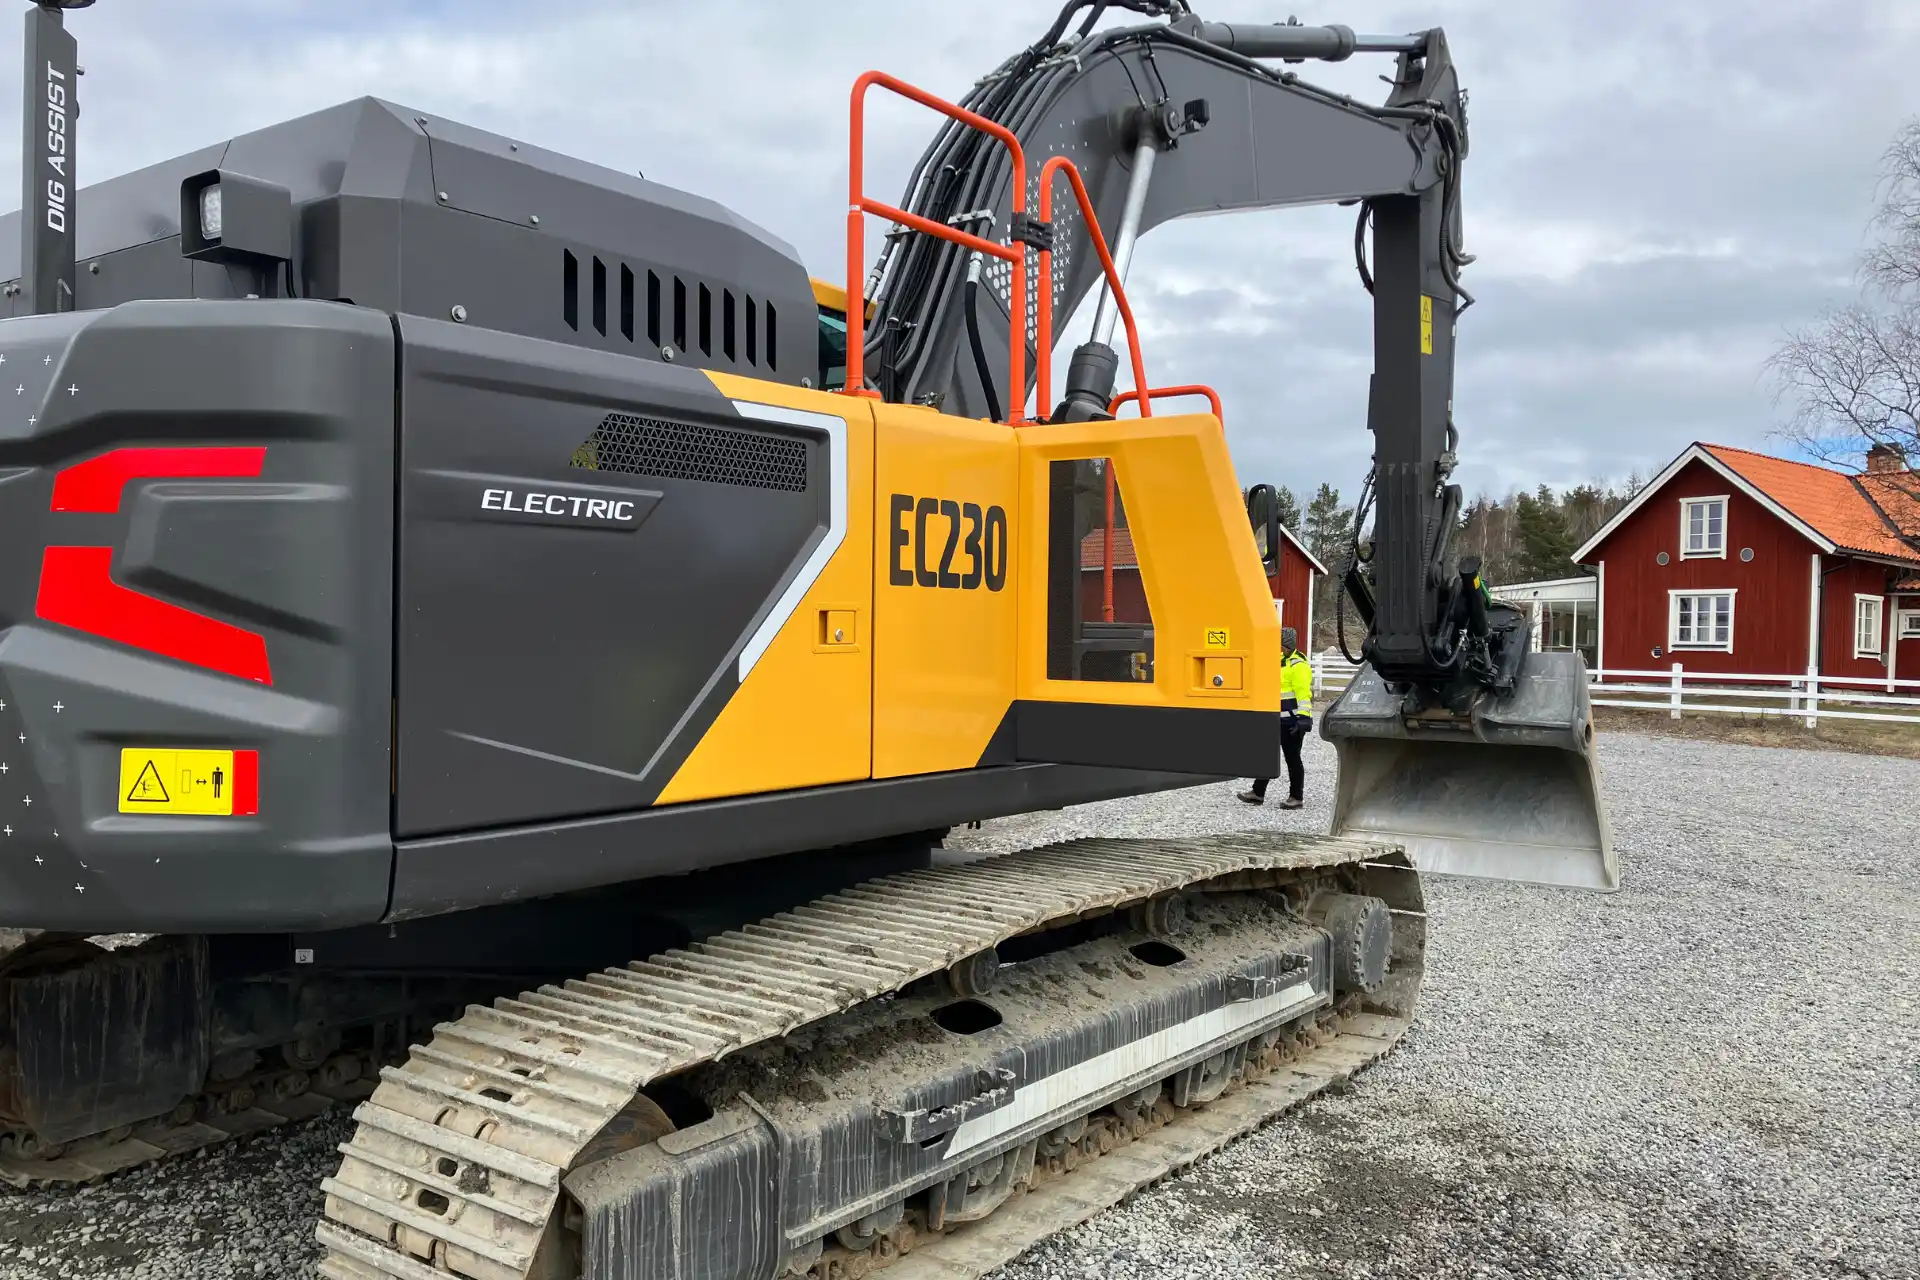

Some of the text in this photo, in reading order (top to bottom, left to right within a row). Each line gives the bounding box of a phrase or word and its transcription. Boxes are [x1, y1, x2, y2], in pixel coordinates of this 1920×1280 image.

[48, 60, 65, 233] DIG ASSIST
[481, 489, 634, 521] ELECTRIC
[890, 494, 1007, 592] EC230
